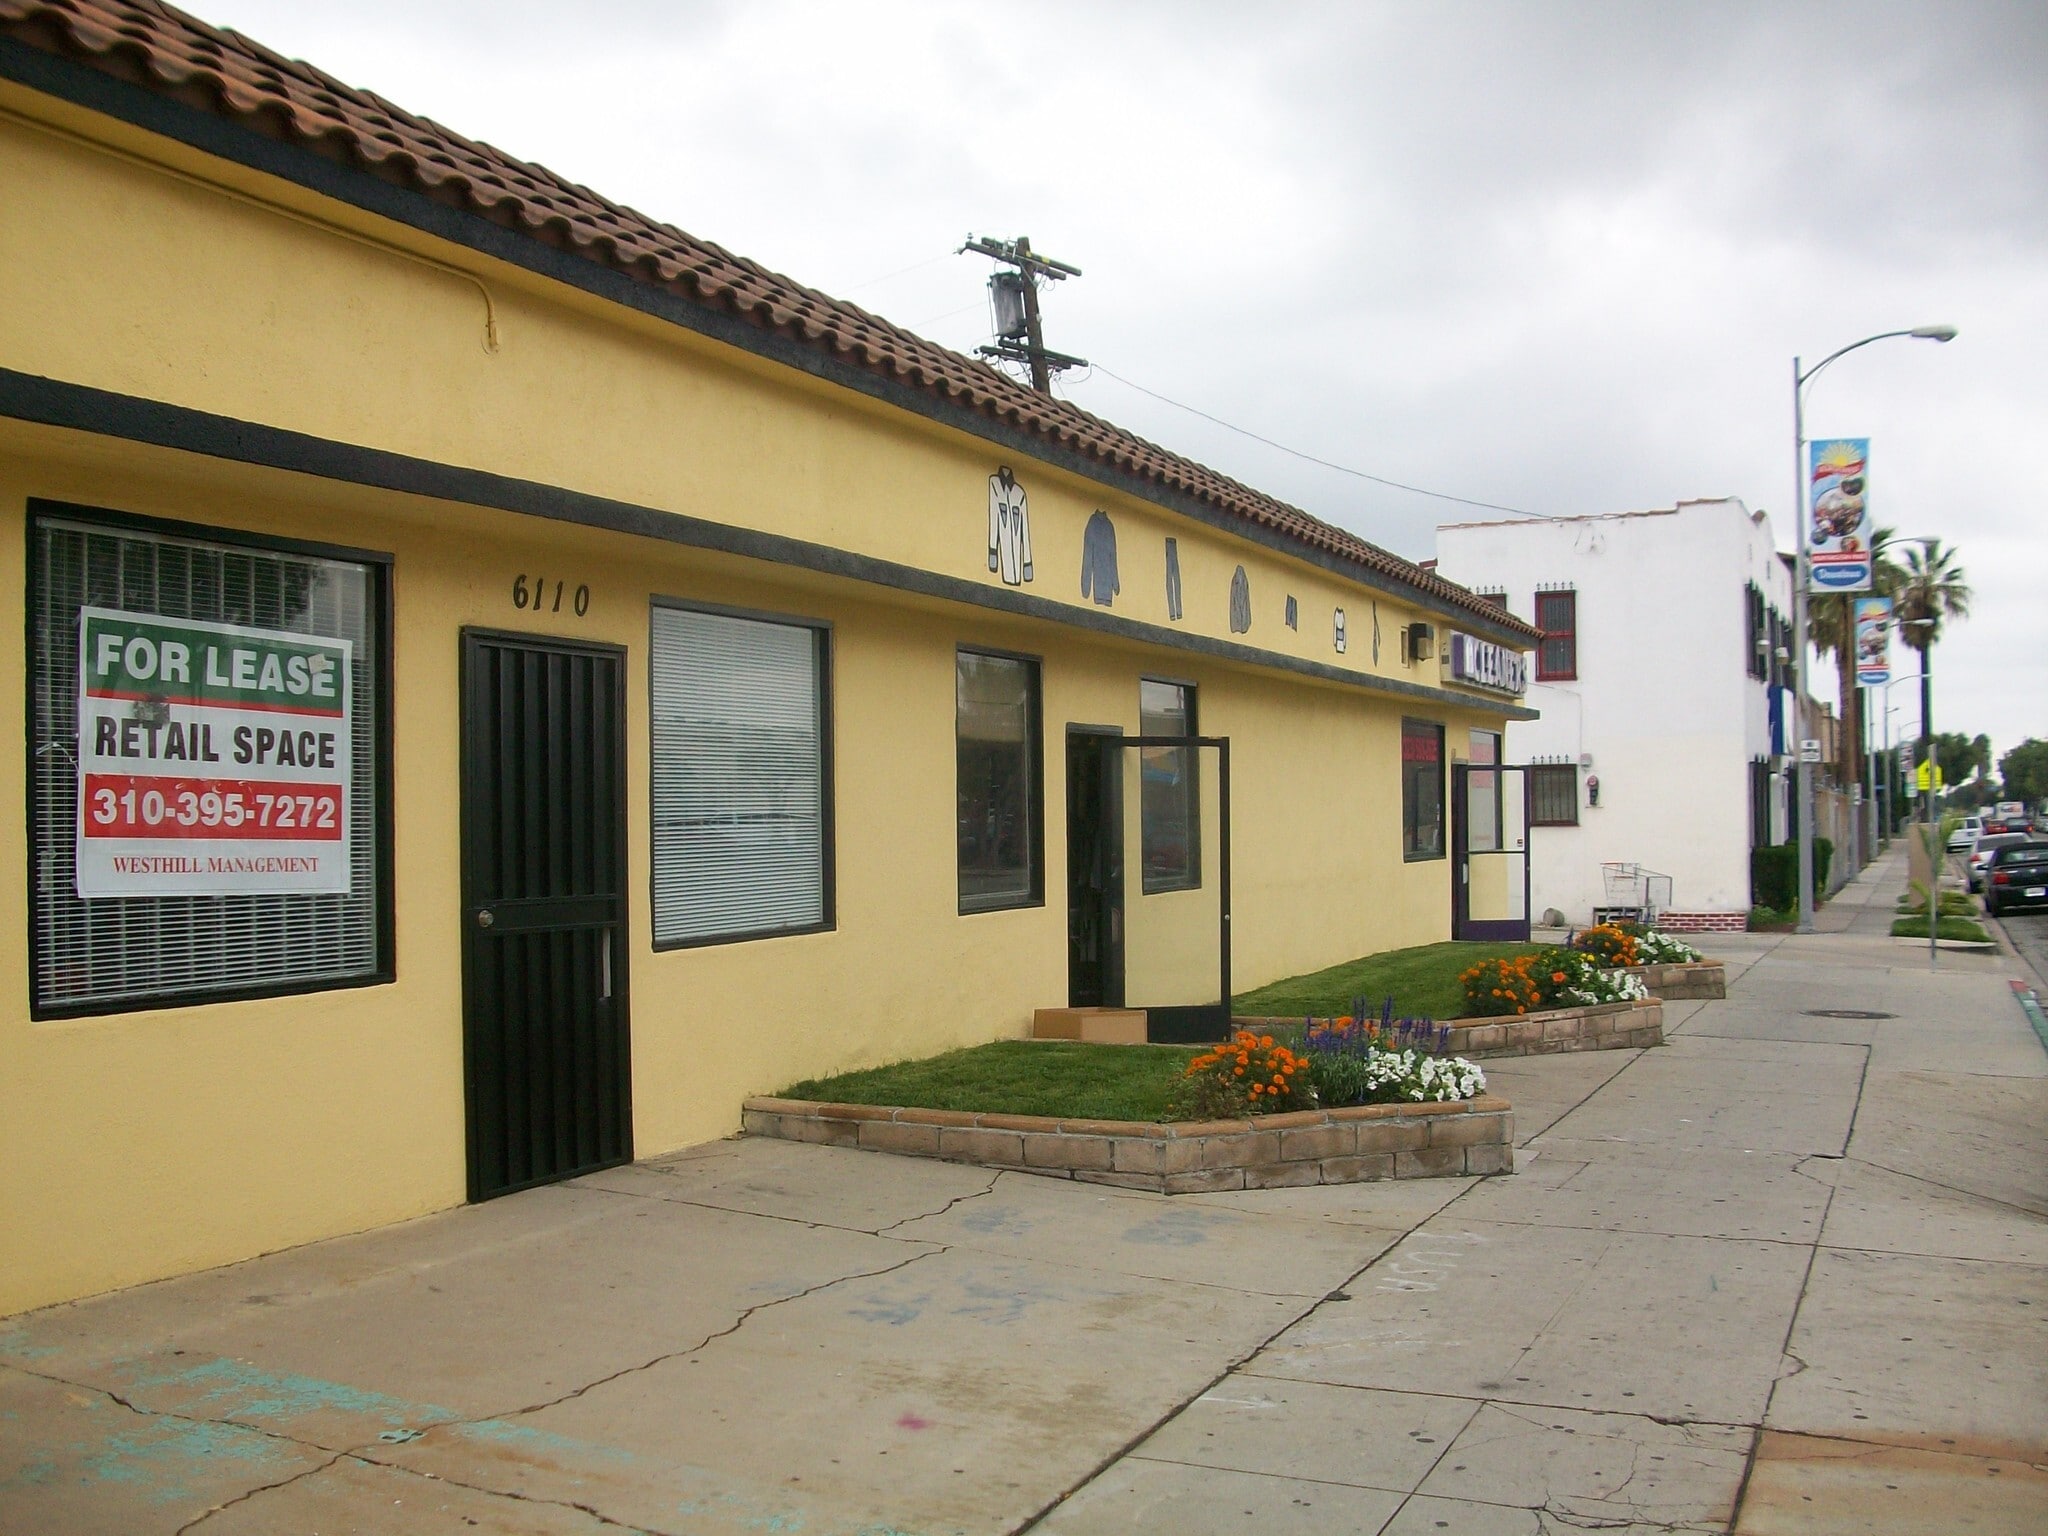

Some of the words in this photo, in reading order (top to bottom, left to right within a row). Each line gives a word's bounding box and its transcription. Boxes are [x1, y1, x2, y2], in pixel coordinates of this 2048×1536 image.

[513, 574, 590, 617] 6110
[97, 633, 190, 683] FOR
[206, 646, 336, 697] LEASE
[95, 716, 219, 762] RETAIL
[233, 726, 335, 768] SPACE
[93, 789, 335, 828] 310-395-7272
[113, 857, 202, 873] WESTHILL
[208, 857, 319, 873] MANAGEMENT
